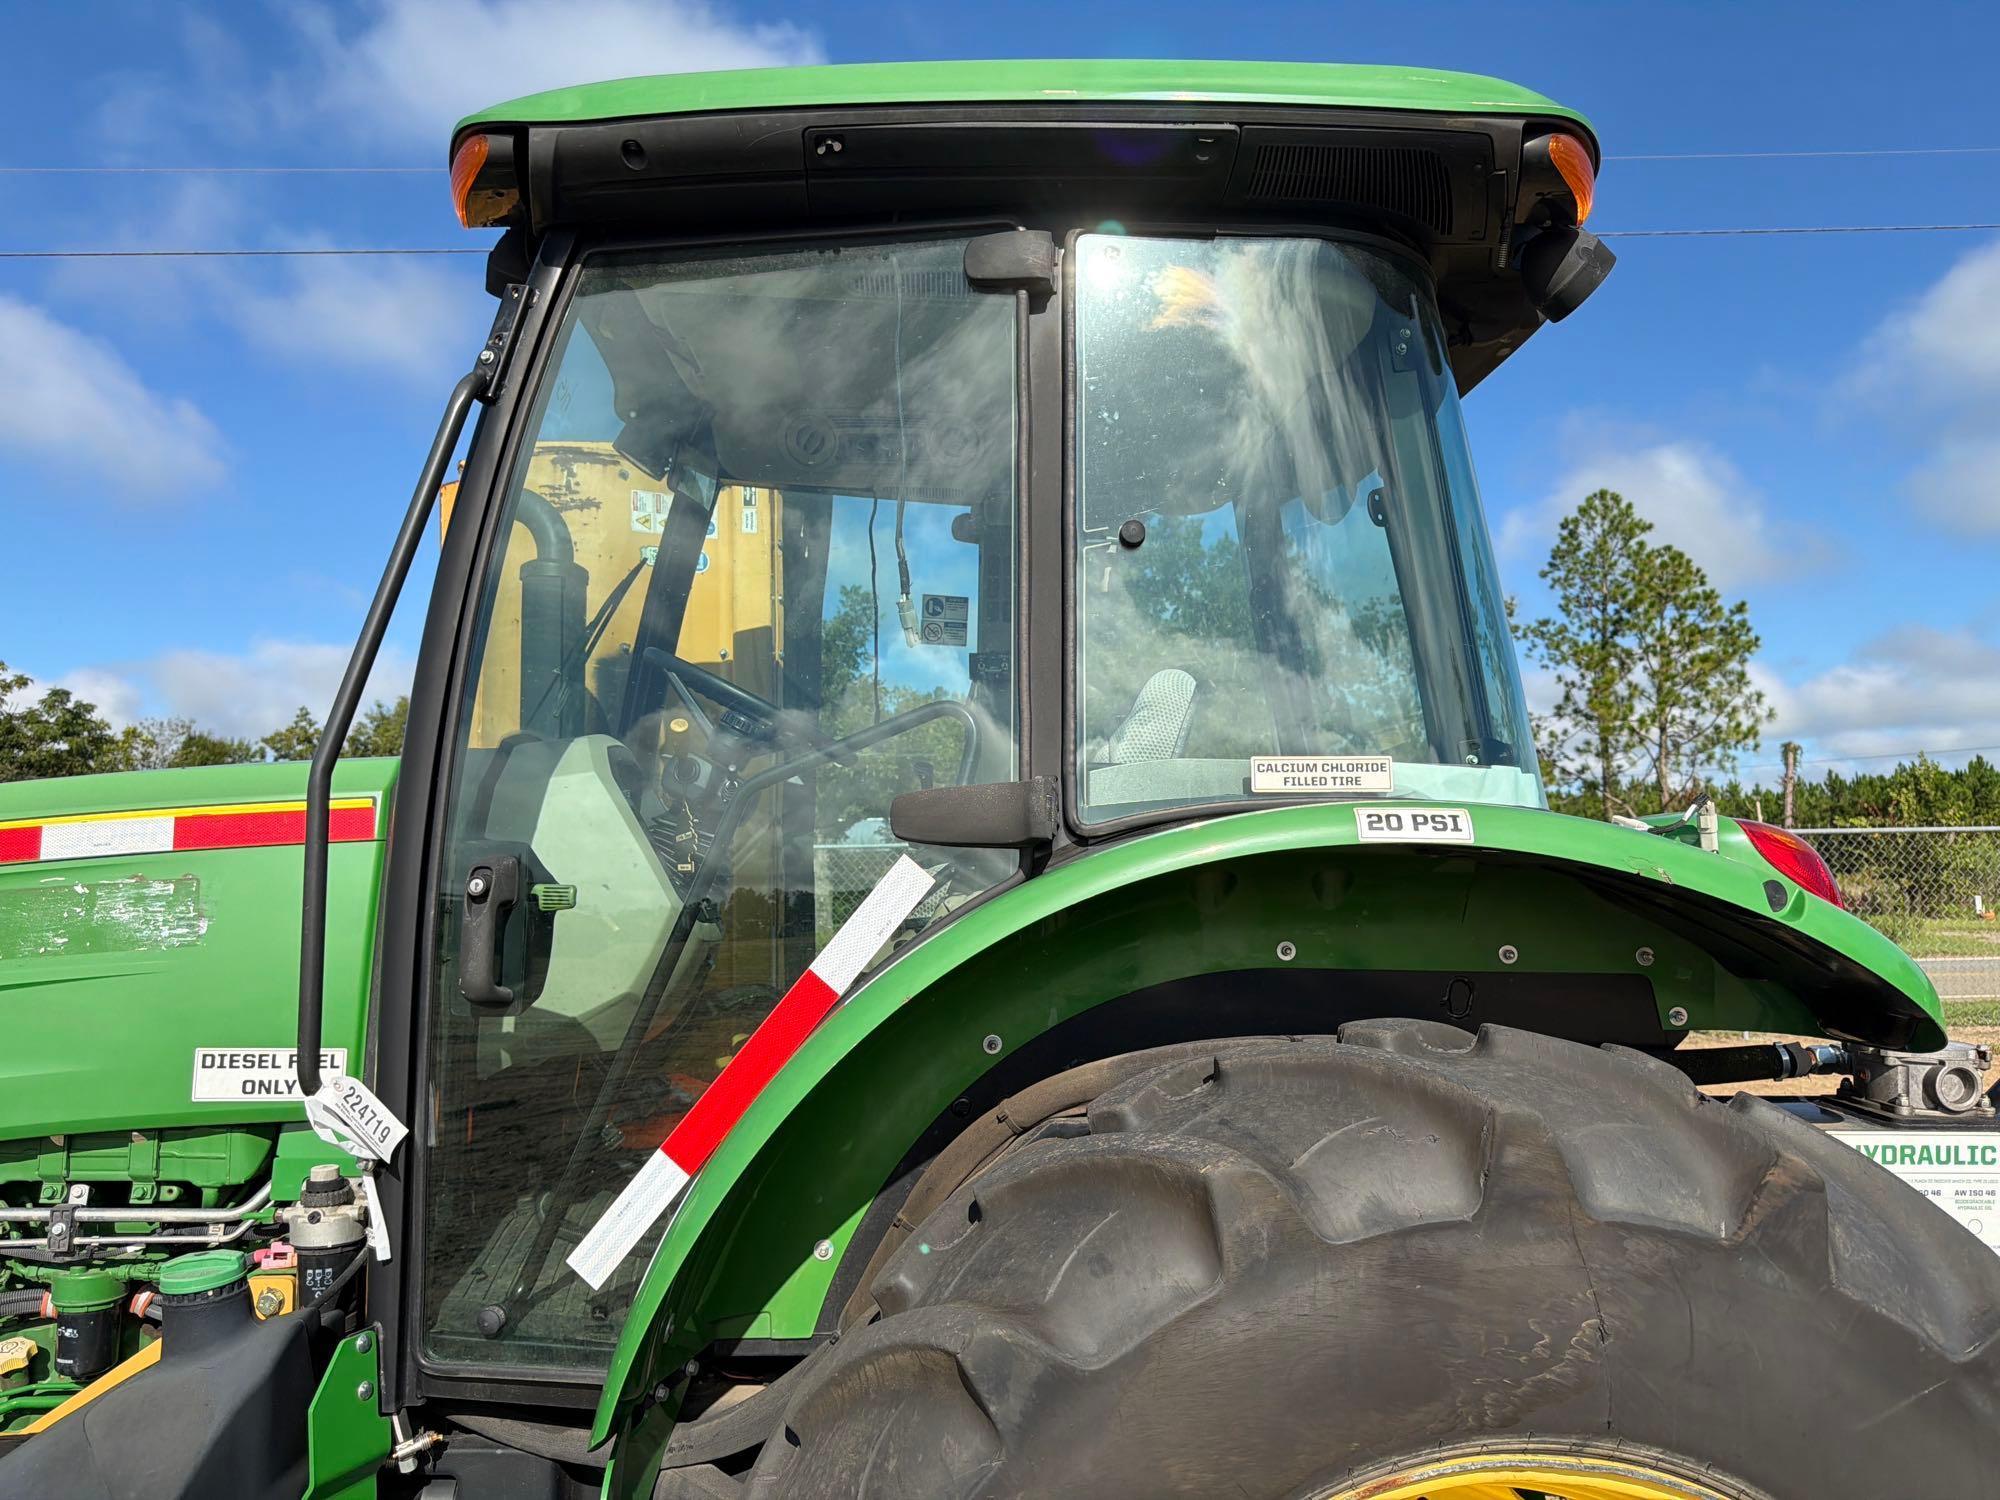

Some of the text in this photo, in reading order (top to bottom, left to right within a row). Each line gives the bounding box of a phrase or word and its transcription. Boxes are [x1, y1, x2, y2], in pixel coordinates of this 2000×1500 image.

[1257, 762, 1387, 773] CALCIUM CHLORIDE
[1283, 776, 1362, 787] FILLED TIRE
[1366, 813, 1463, 832] 20 PSI
[201, 1053, 340, 1069] DIESEL FEL
[241, 1079, 297, 1095] ONLY
[342, 1086, 392, 1144] 224719
[1954, 1189, 1967, 1197] AW
[1969, 1189, 1983, 1197] ISO
